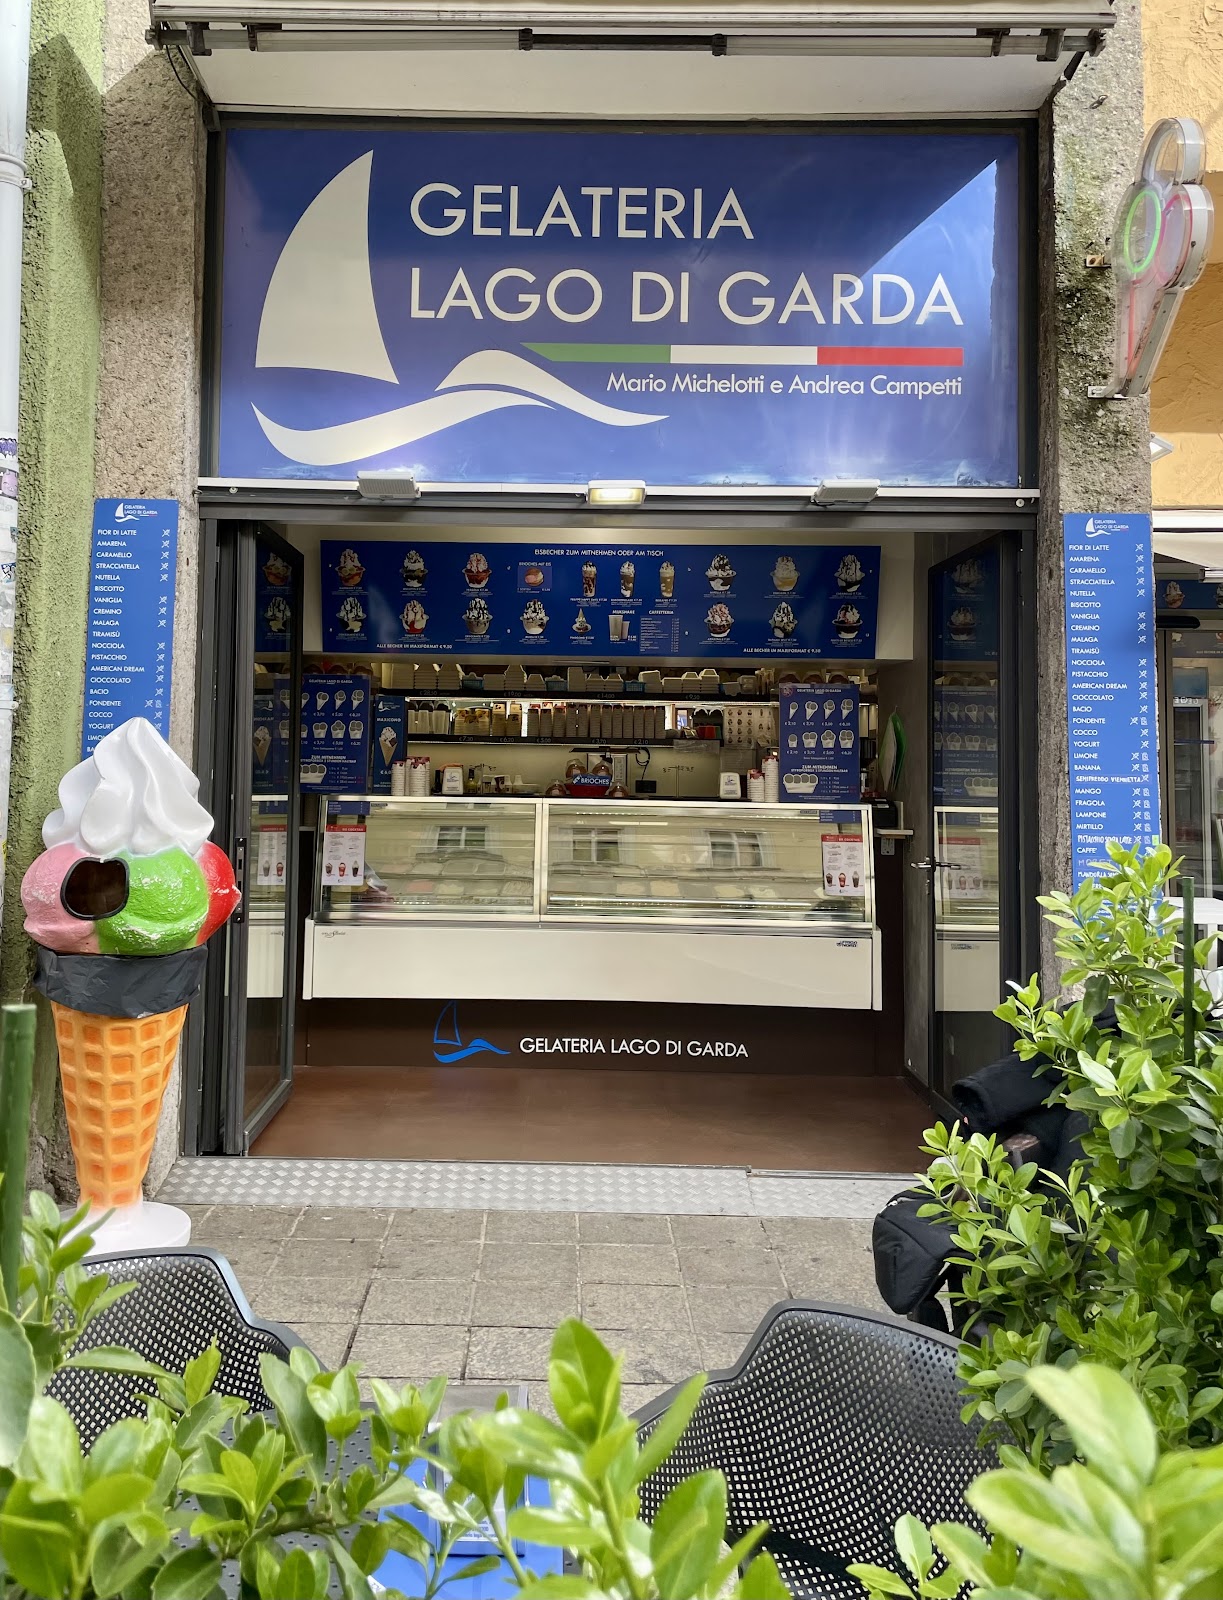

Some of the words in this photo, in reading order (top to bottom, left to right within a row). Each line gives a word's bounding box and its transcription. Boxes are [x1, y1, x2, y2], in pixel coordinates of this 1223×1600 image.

[410, 182, 754, 240] GELATERIA
[410, 267, 602, 323] LAGO
[632, 272, 690, 324] DI
[718, 271, 964, 326] GARDA
[607, 372, 667, 393] Mario
[671, 373, 766, 395] Michelotti
[769, 381, 784, 395] e
[788, 373, 865, 396] Andrea
[869, 374, 964, 400] Campetti
[520, 1037, 606, 1054] GELATERIA
[611, 1038, 660, 1055] LAGO
[665, 1040, 682, 1056] DI
[687, 1040, 748, 1058] GARDA
